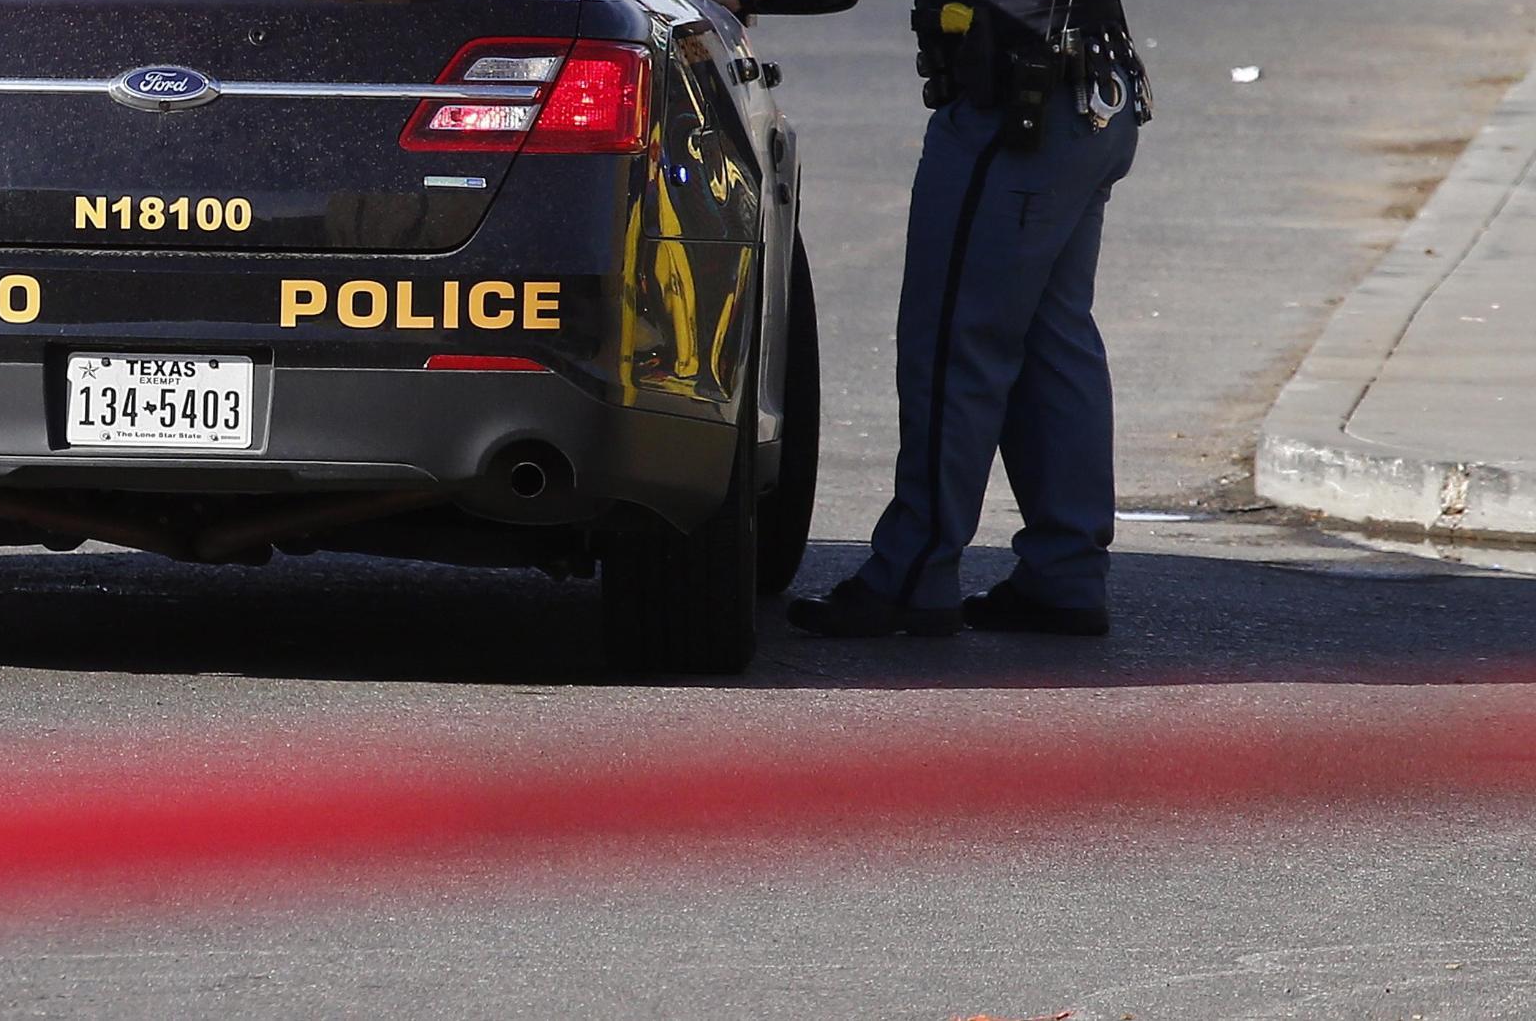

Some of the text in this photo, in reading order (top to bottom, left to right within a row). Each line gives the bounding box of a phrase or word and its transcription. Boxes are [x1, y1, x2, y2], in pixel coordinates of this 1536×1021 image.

[139, 71, 189, 92] Ford
[75, 196, 252, 232] N18100
[279, 278, 562, 331] POLICE
[126, 360, 196, 377] TEXAS
[139, 377, 182, 386] EXEMPT
[116, 430, 132, 438] The
